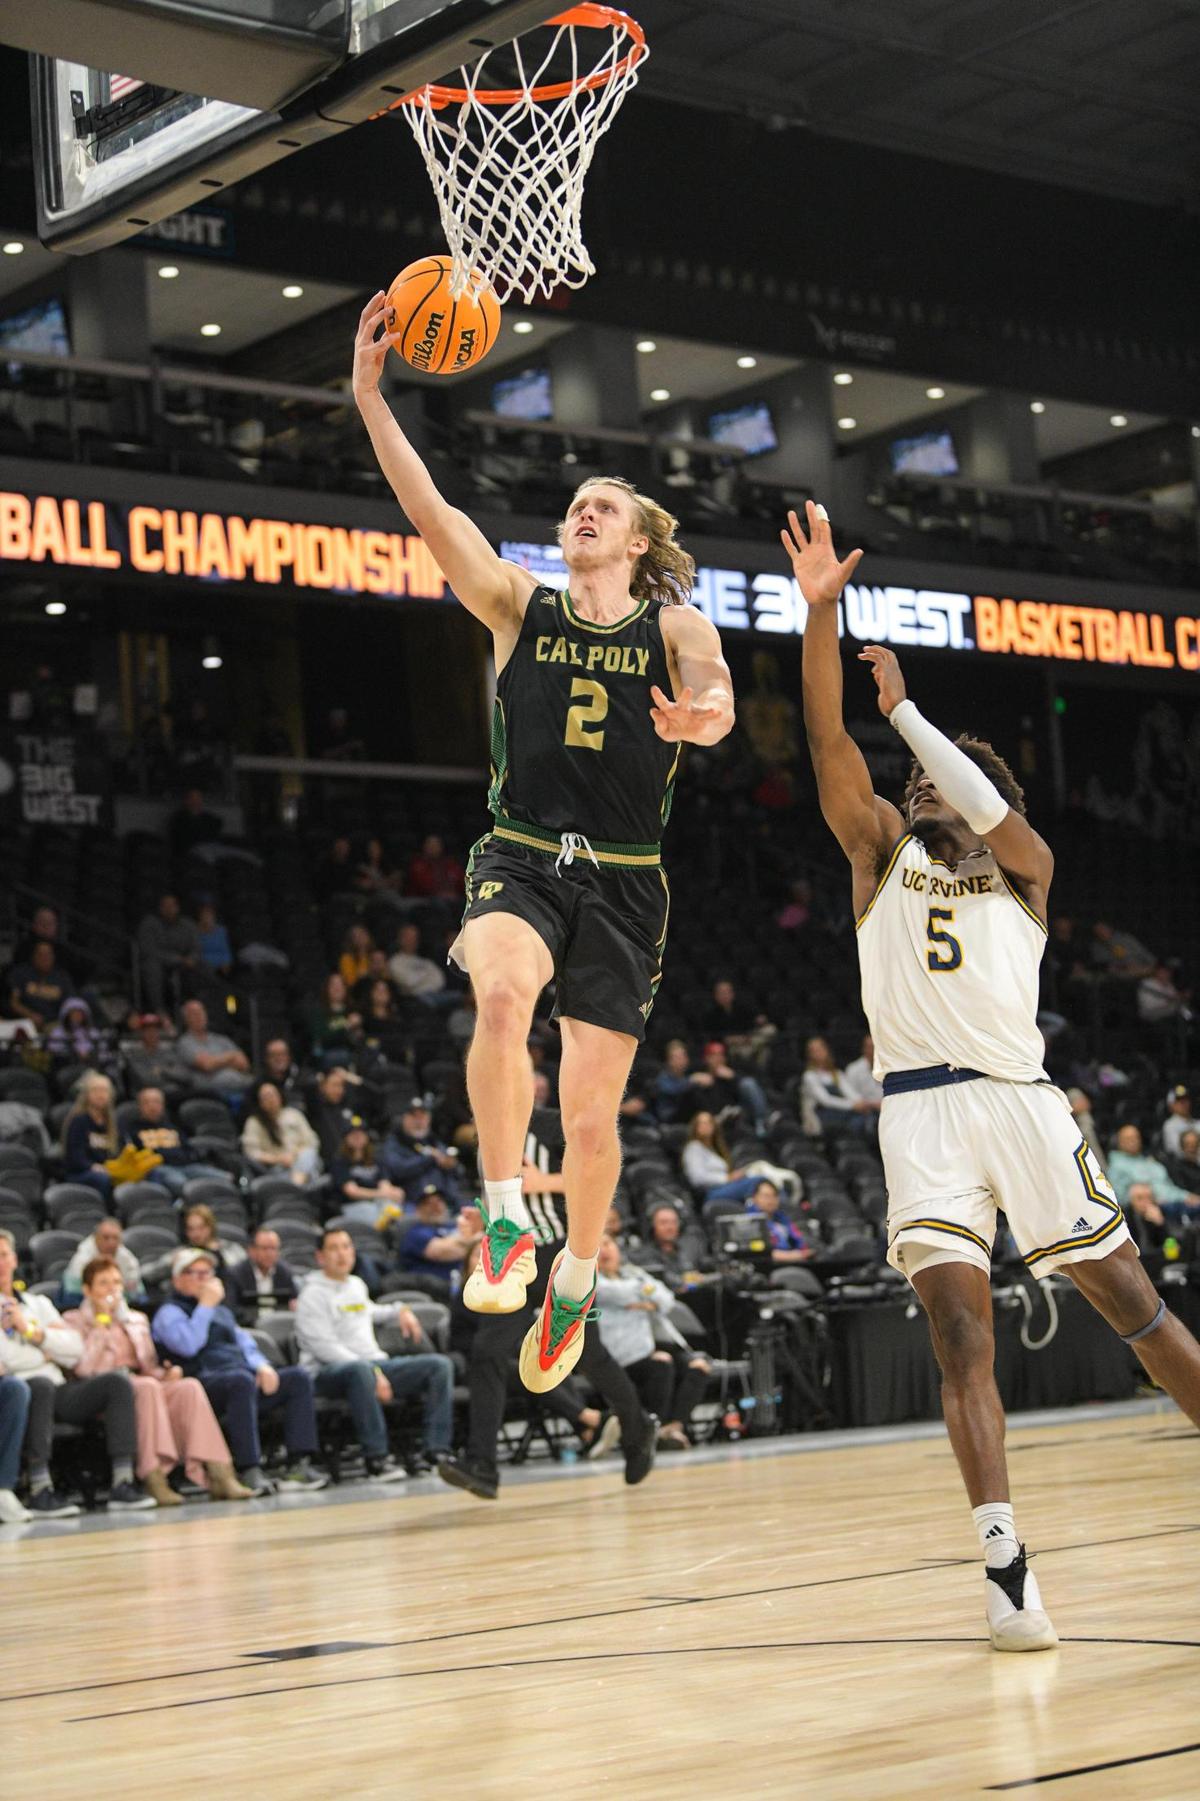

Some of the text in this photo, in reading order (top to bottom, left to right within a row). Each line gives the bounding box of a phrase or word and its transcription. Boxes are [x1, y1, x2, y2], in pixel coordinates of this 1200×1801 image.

[411, 313, 445, 370] Wilson
[0, 492, 121, 569] BALL
[691, 567, 750, 630] HE
[974, 596, 1174, 669] BASKETBALL
[1175, 616, 1200, 671] C
[535, 635, 650, 677] CAL POLY
[564, 677, 609, 752] 2
[21, 794, 103, 825] WEST
[901, 866, 993, 898] UC RVINE
[925, 906, 964, 973] 5
